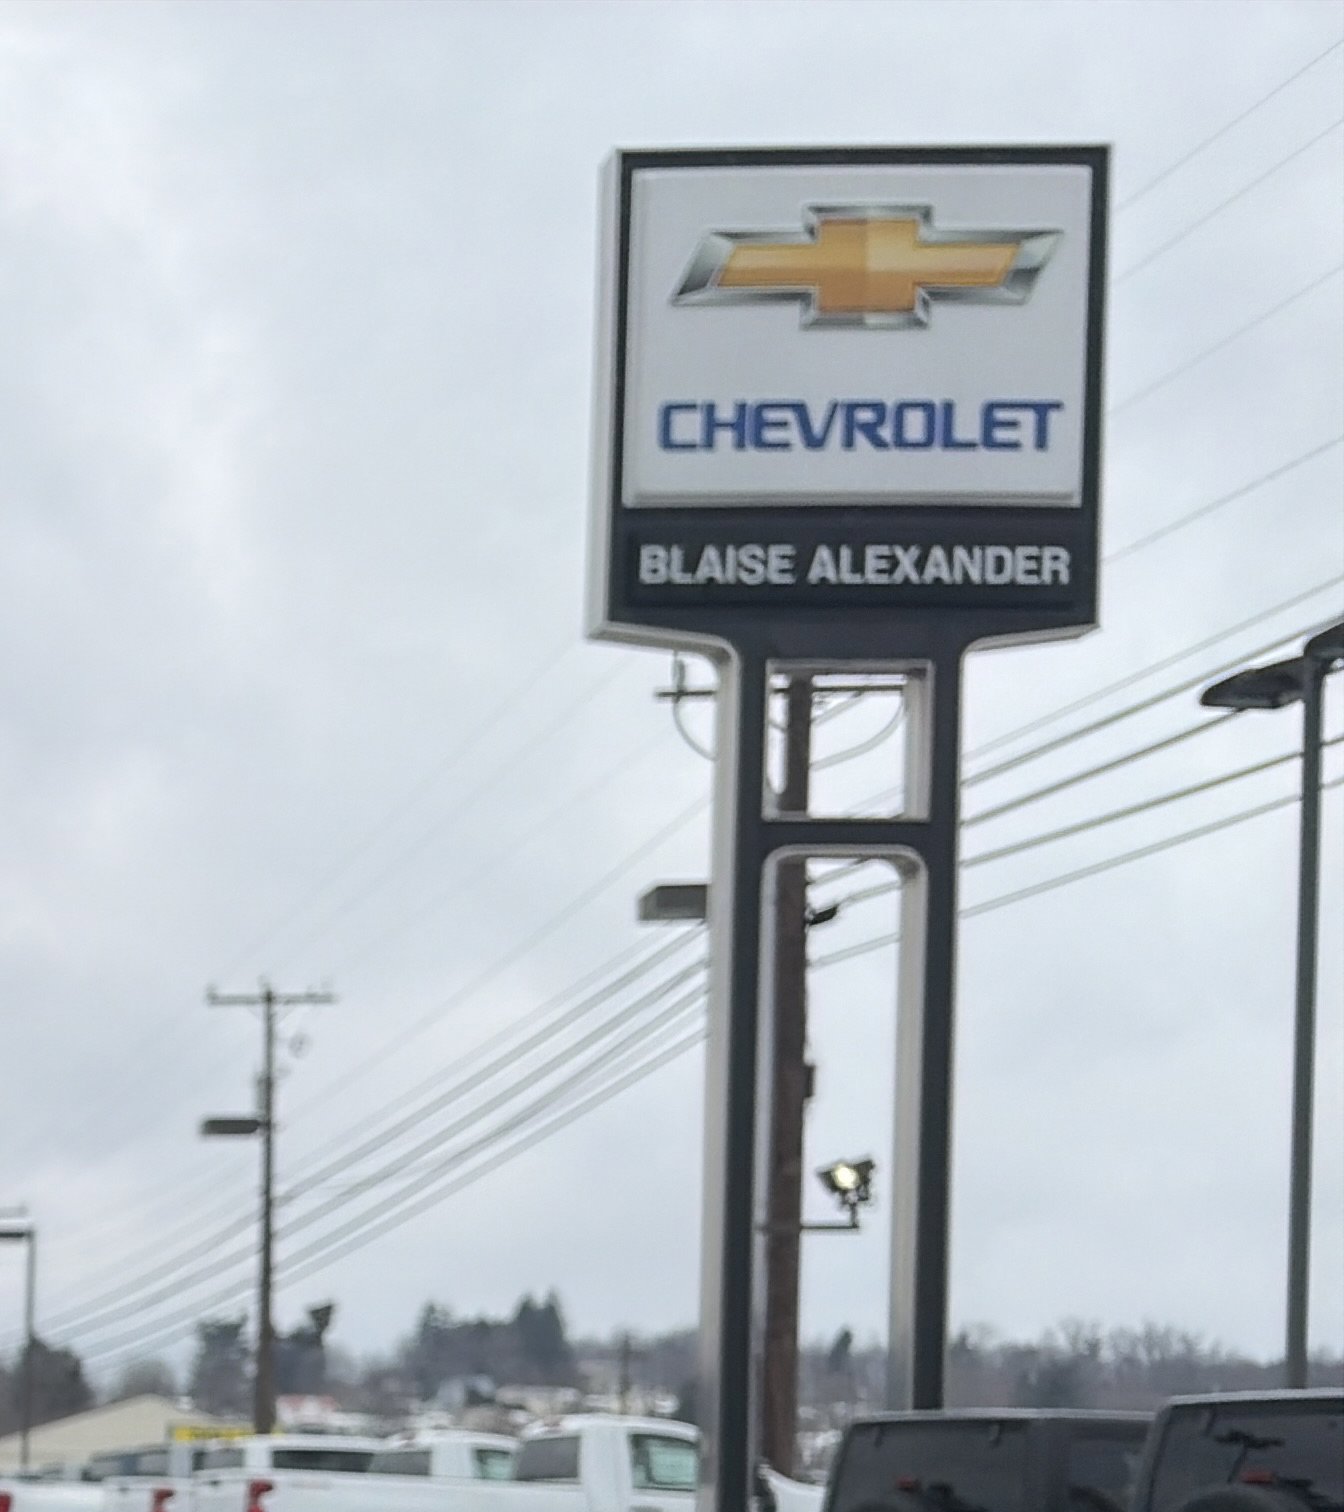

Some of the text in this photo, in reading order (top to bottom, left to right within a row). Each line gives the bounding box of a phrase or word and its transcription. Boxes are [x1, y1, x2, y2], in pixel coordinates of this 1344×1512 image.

[657, 399, 1065, 452] CHEVROLET
[637, 543, 1071, 586] BLAISE ALEXANDER
